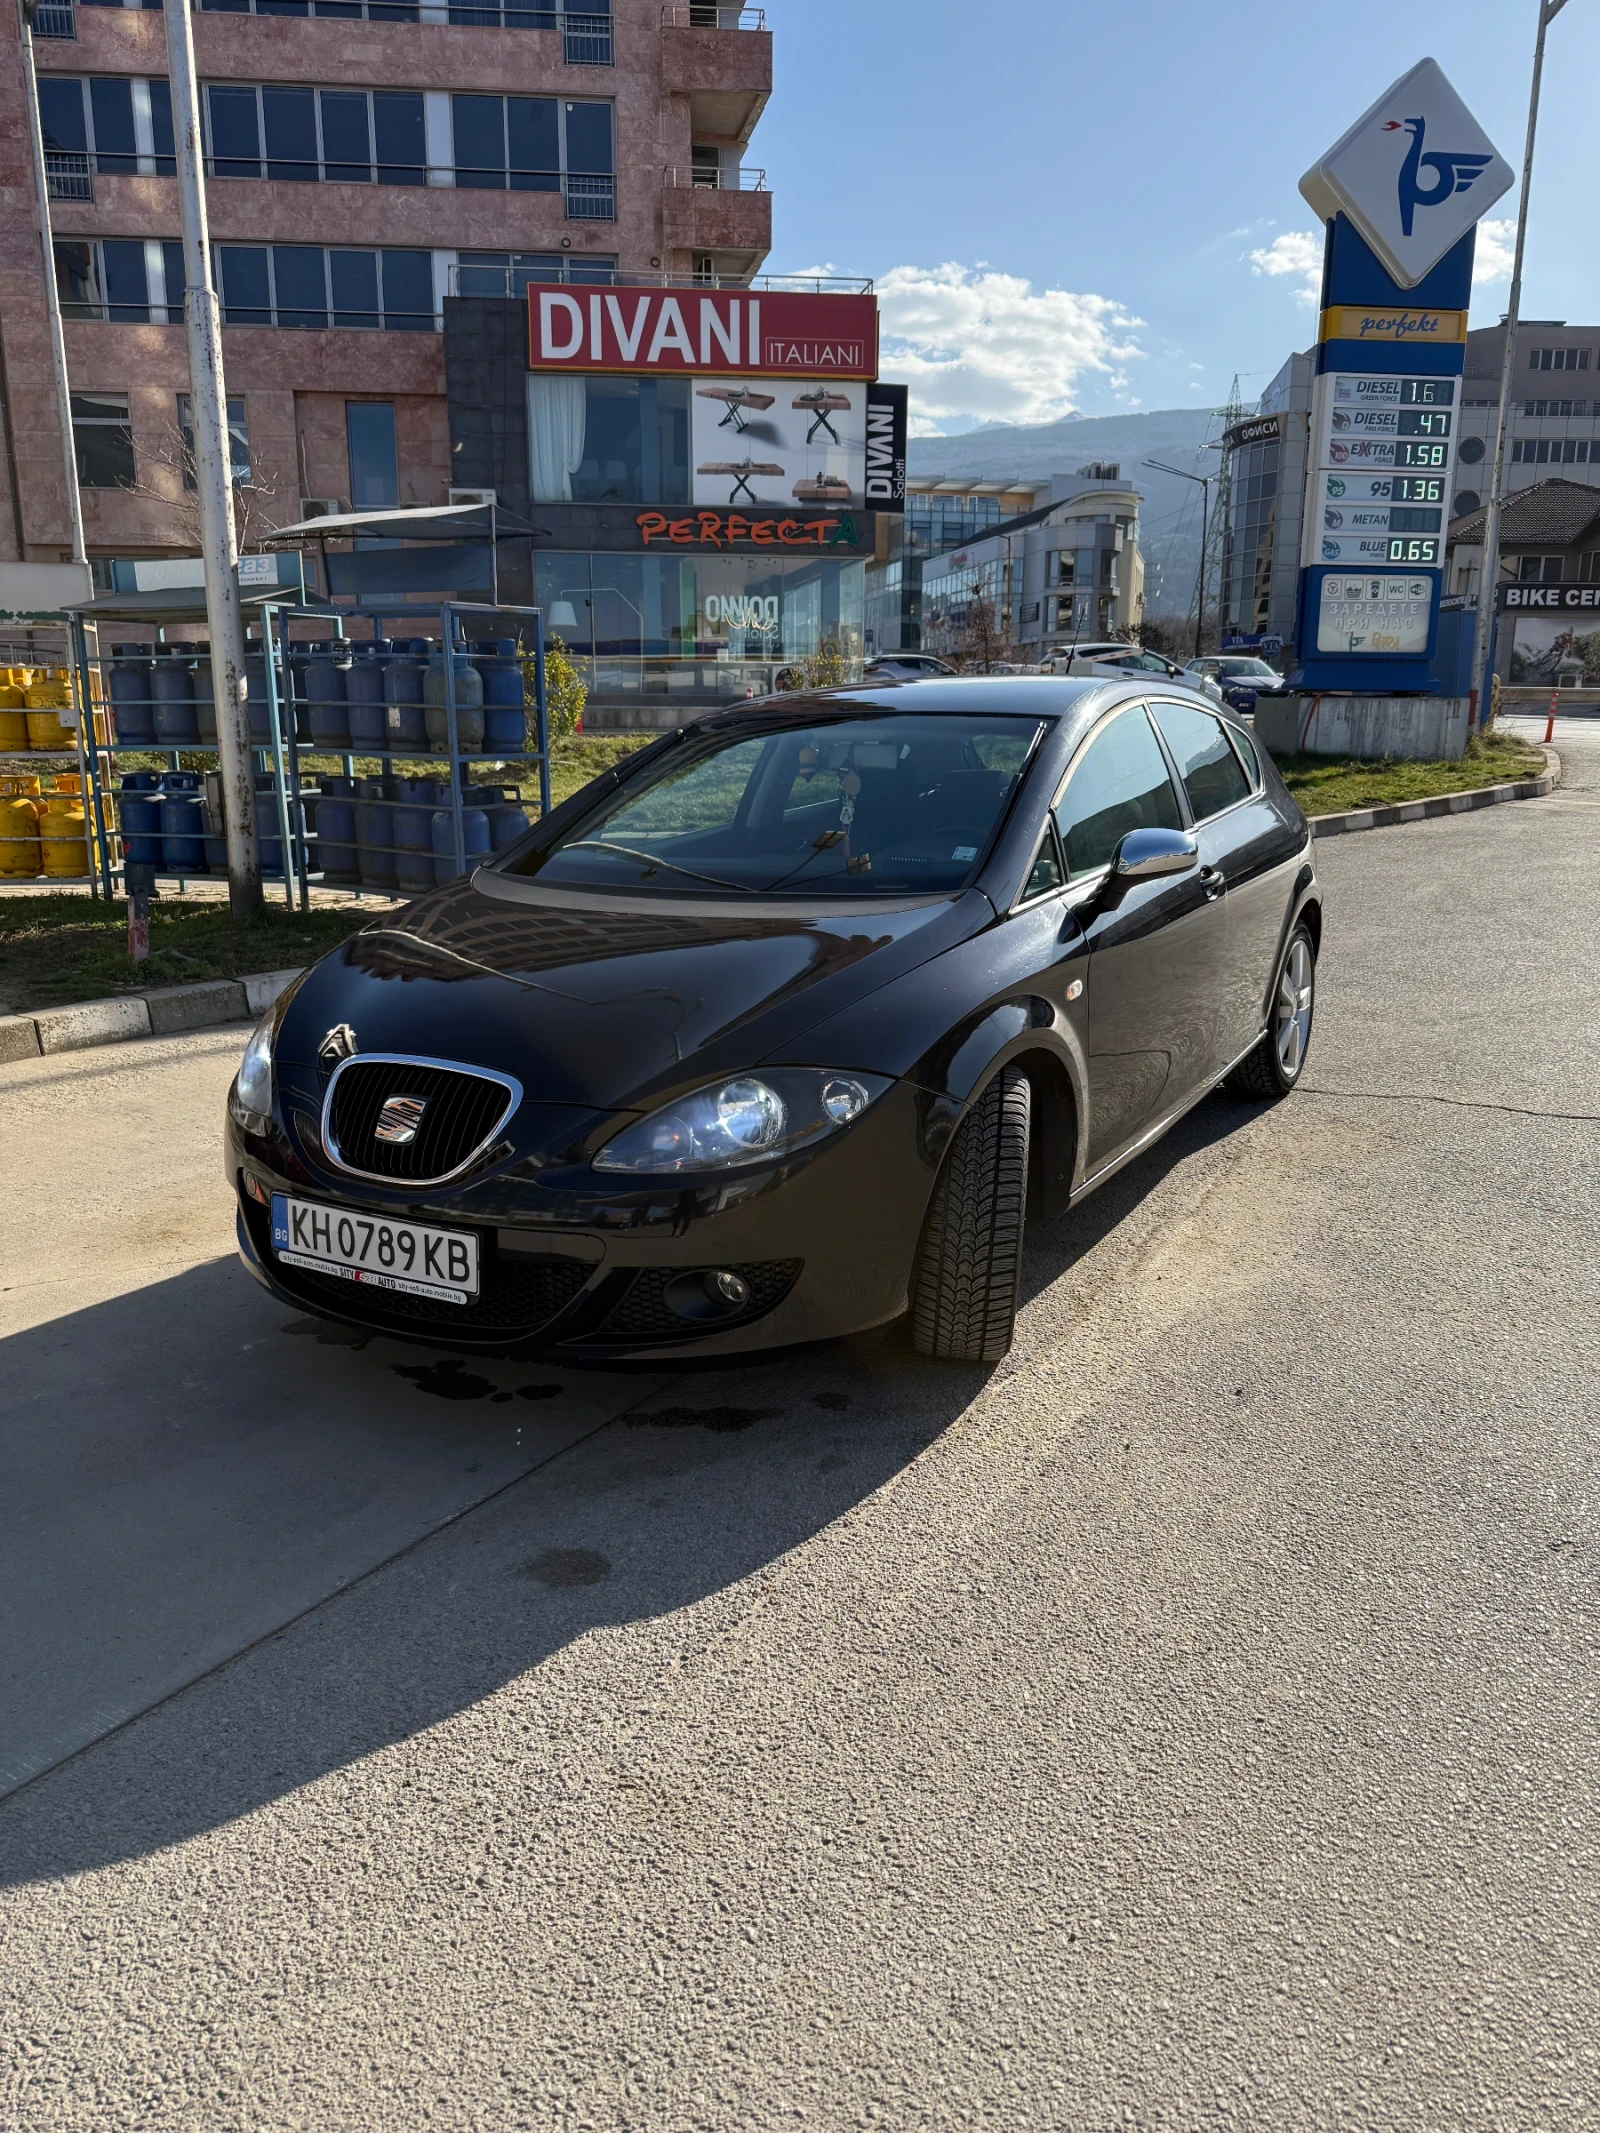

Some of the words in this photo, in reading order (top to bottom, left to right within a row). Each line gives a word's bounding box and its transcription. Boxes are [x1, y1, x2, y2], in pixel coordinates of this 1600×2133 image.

[539, 292, 761, 366] DIVANI
[769, 342, 860, 366] ITALIANI
[1360, 313, 1439, 338] perfekt
[1356, 380, 1400, 395] DIESEL
[1354, 412, 1398, 426] DIESEL
[1241, 421, 1278, 440] ОФИСИ
[866, 404, 894, 499] DIVANI
[1334, 451, 1349, 460] 100
[1405, 444, 1444, 466] 1.58
[893, 458, 905, 499] Salotti
[1331, 486, 1344, 496] 95
[1370, 481, 1392, 497] 95
[1402, 480, 1440, 501] 1.36
[1352, 514, 1389, 525] METAN
[636, 512, 860, 549] PERFECTA
[1324, 548, 1340, 556] GAS
[1359, 541, 1387, 552] BLUE
[1389, 540, 1435, 561] 0.65
[1389, 585, 1404, 594] WC
[1506, 588, 1560, 606] BIKE
[1329, 603, 1420, 616] ЗАРЕДЕТЕ
[1334, 618, 1370, 630] ПРИ
[1379, 618, 1414, 630] НАС
[1231, 636, 1244, 645] VTA
[1263, 642, 1280, 650] VTA
[275, 1227, 288, 1242] BG
[339, 1267, 355, 1280] SITY
[377, 1276, 396, 1289] AUTO
